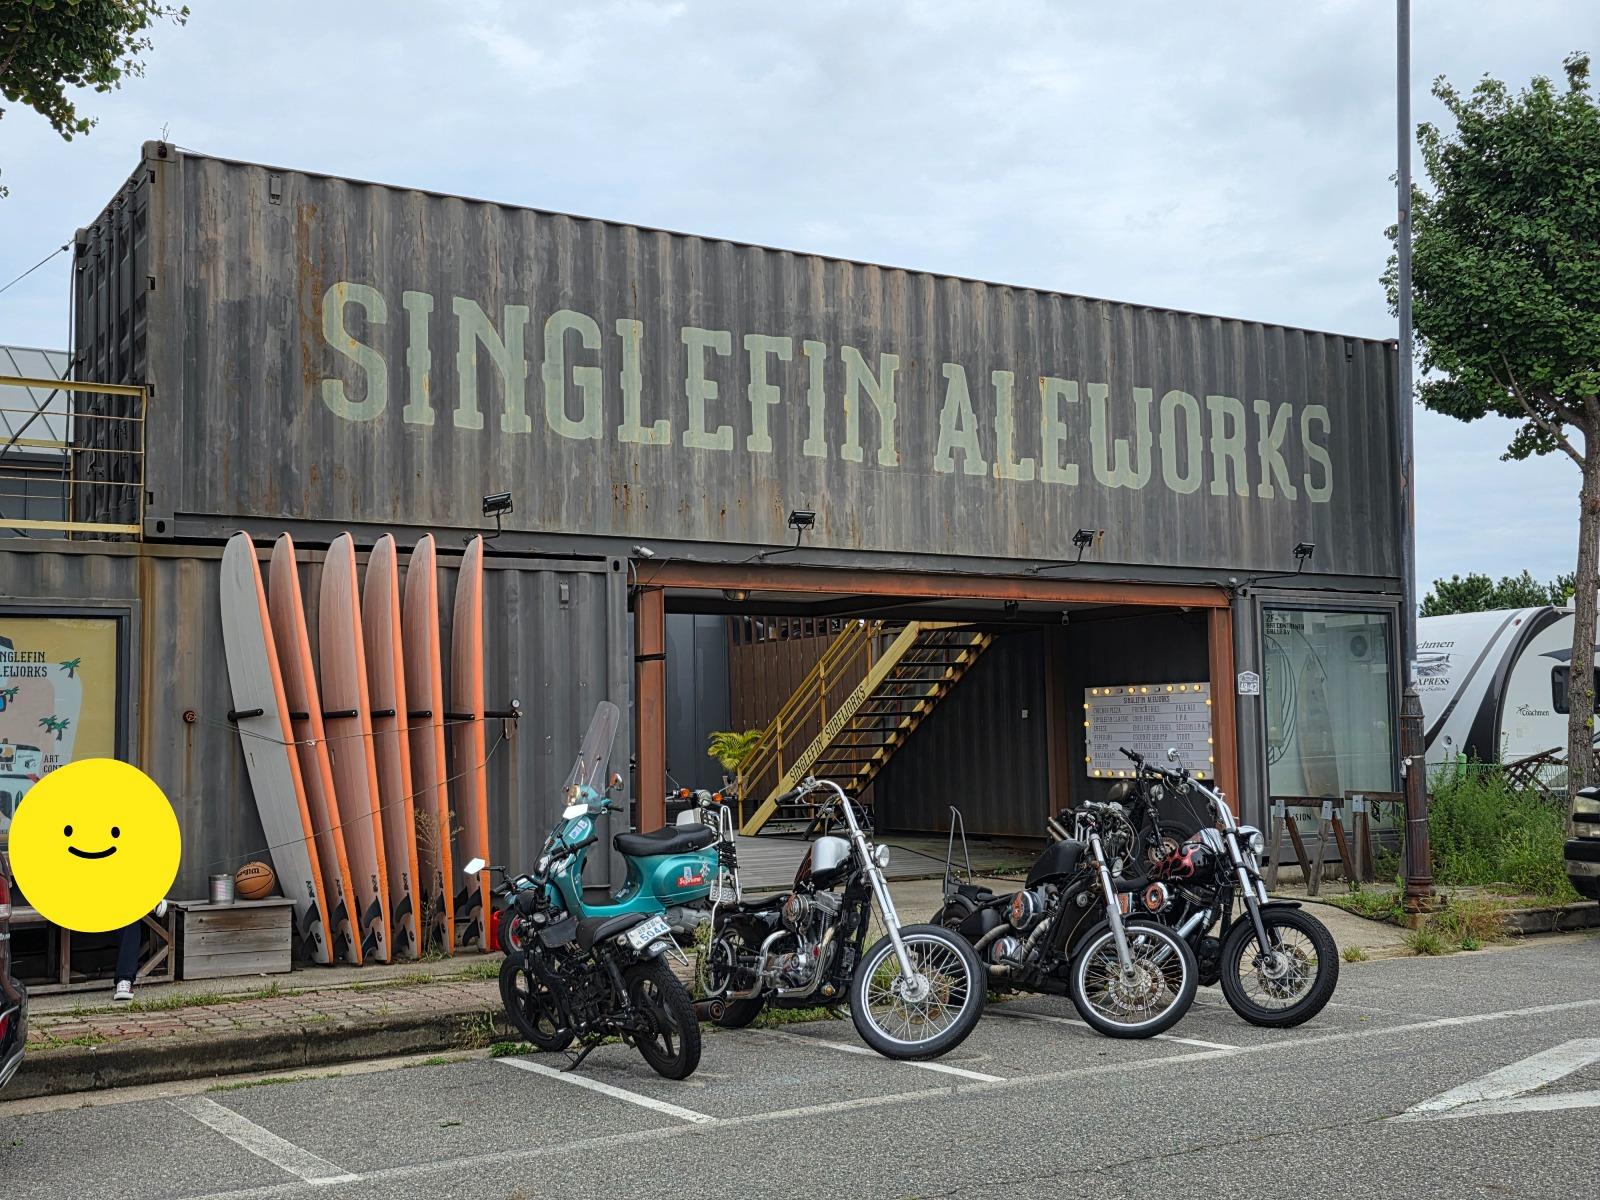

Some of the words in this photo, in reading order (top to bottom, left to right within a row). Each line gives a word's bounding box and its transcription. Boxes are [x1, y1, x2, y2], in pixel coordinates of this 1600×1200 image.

[322, 281, 900, 467] SINGLEFIN
[934, 363, 1334, 503] ALEWORKS
[0, 666, 48, 678] EWORKS
[1417, 677, 1451, 686] XPRESS
[1521, 709, 1550, 717] Coachmen
[789, 736, 824, 783] SINGLEFIN
[823, 685, 866, 741] SURFWORKS
[43, 754, 60, 763] ART
[1293, 812, 1312, 822] SION
[639, 923, 668, 941] 5044
